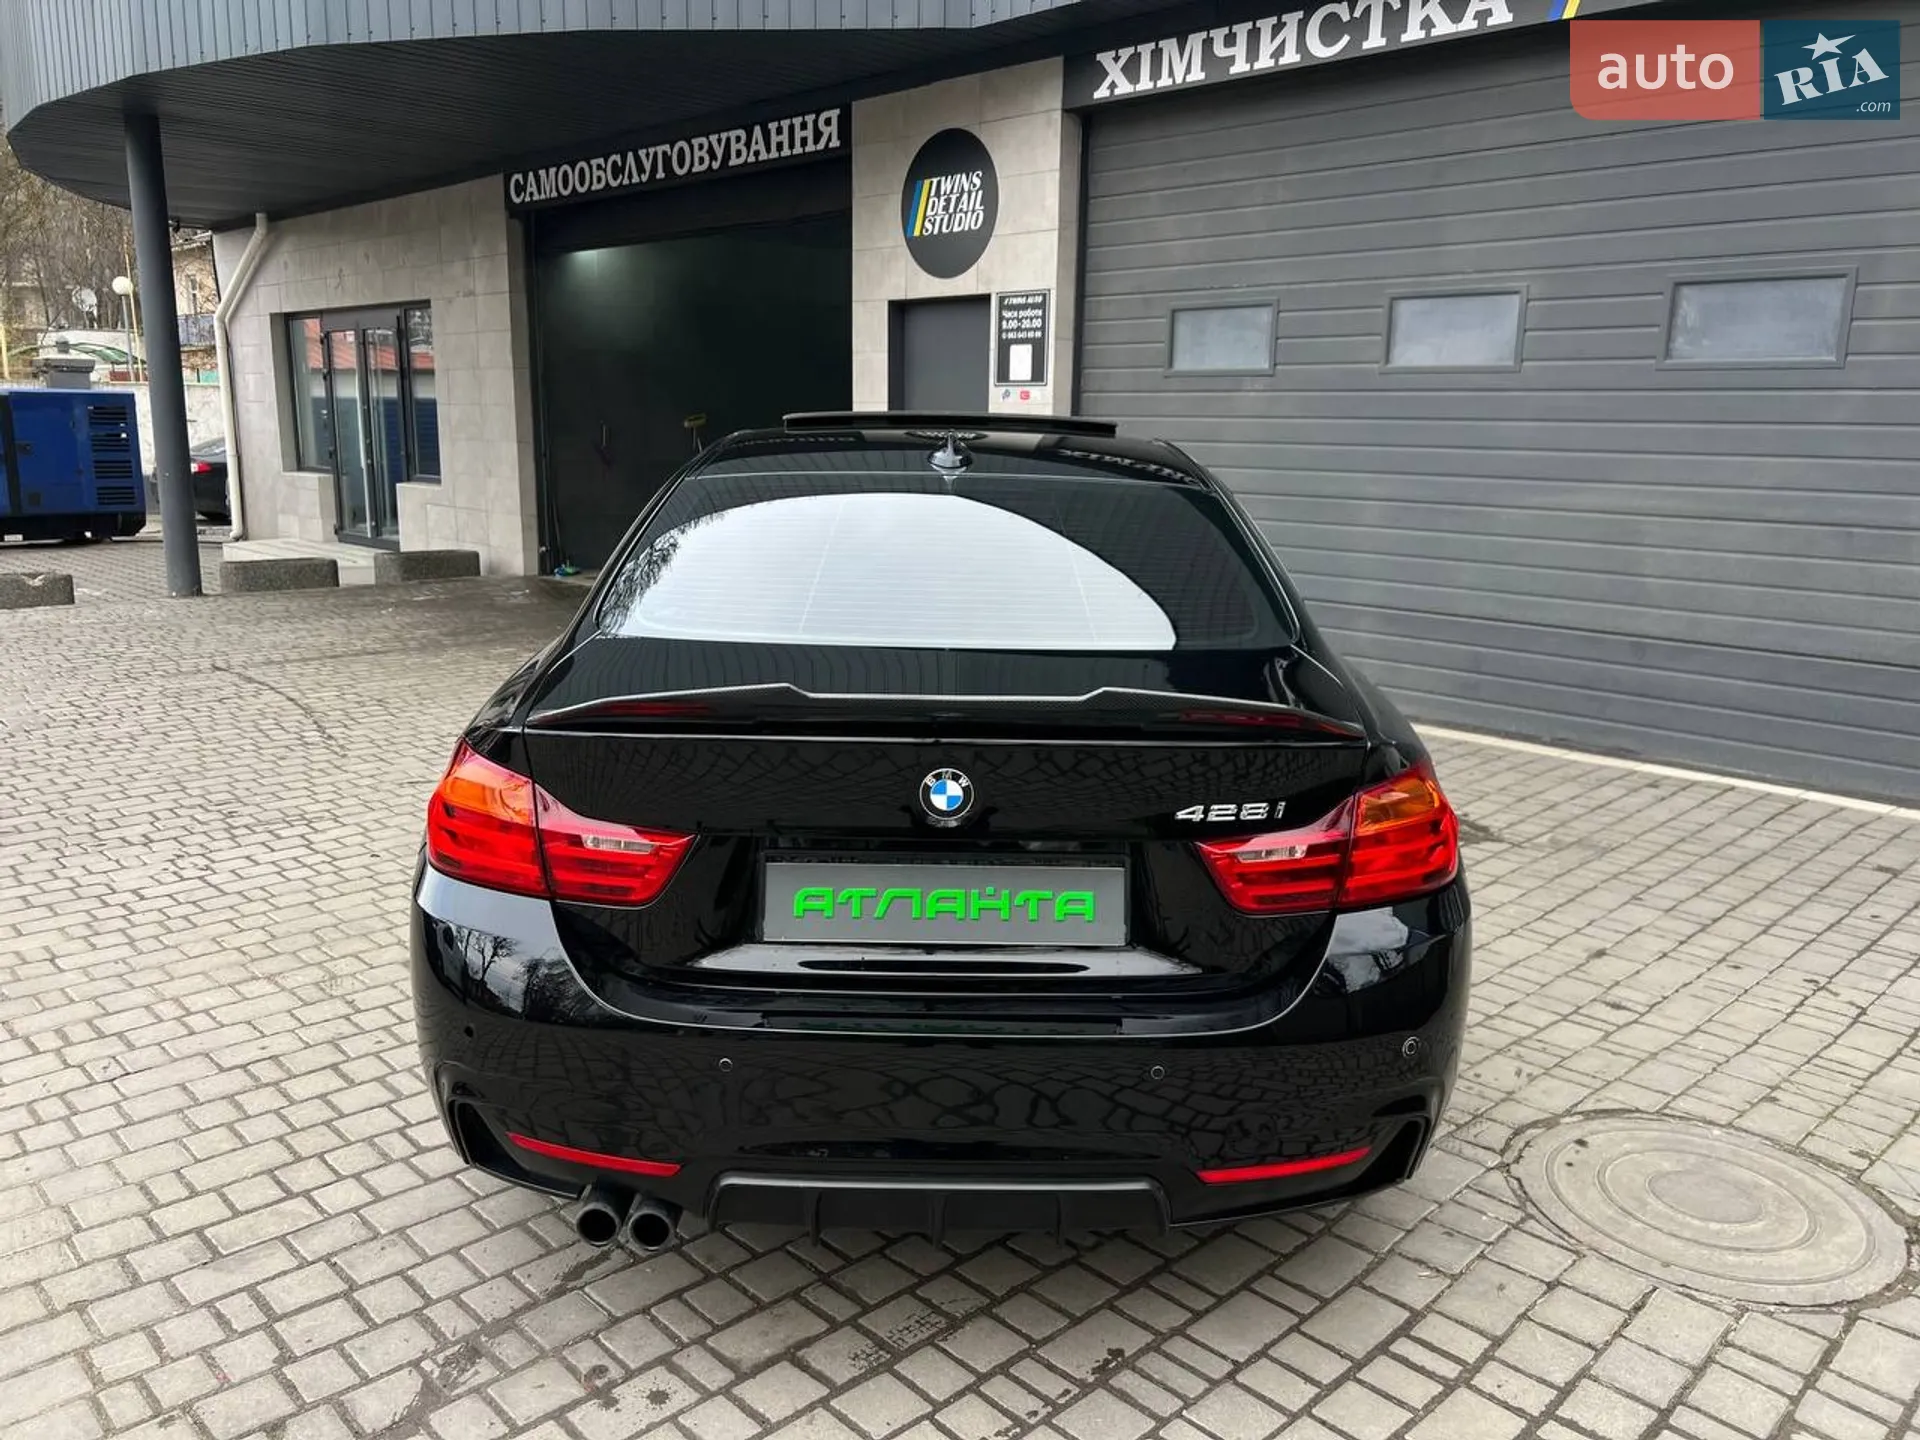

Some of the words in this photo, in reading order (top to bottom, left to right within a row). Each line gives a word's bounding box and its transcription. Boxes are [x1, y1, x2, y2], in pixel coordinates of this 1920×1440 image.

[1093, 0, 1513, 99] ХІМЧИСТКА
[510, 108, 842, 204] САМООБСЛУГОВУВАННЯ
[928, 171, 983, 197] TWINS
[926, 190, 985, 217] DETAIL
[922, 210, 984, 236] STUDIO
[925, 770, 969, 787] BMW
[1175, 801, 1286, 822] 428i
